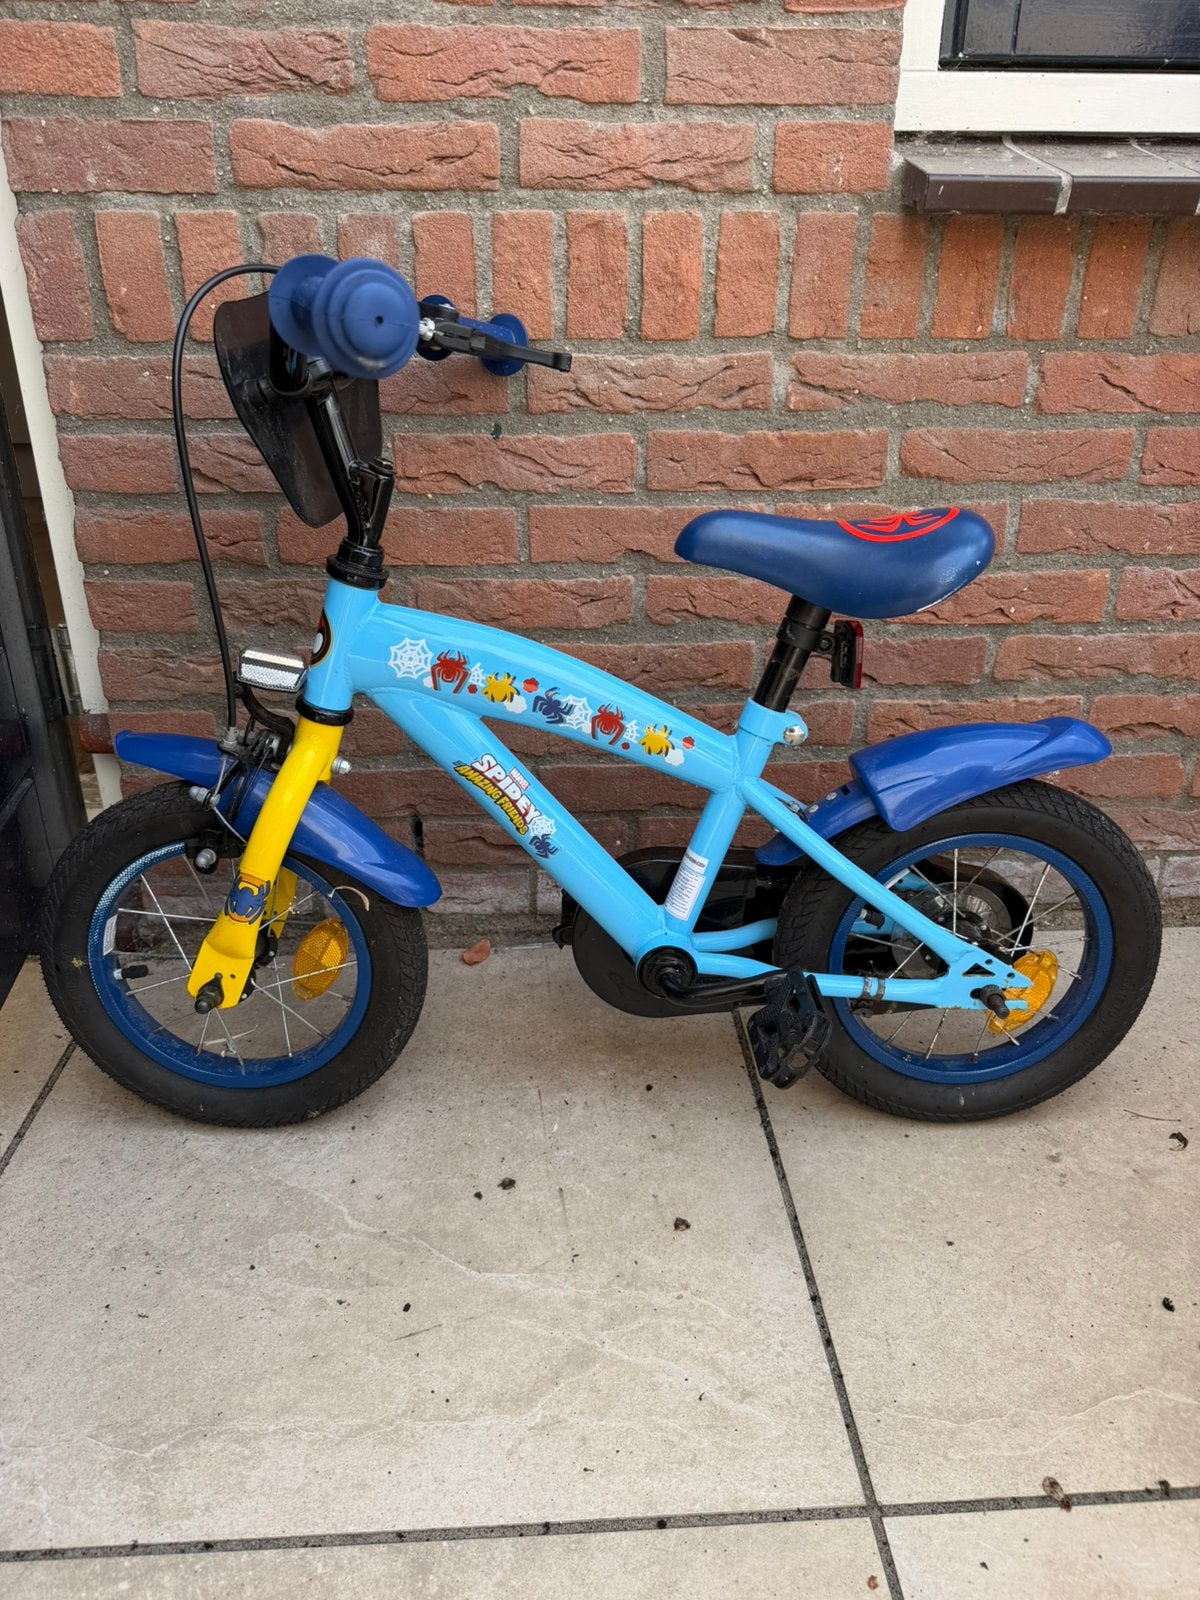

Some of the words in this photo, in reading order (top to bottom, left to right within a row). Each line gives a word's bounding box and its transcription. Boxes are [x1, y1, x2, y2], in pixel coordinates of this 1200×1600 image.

[455, 765, 502, 800] AMAZING
[497, 796, 528, 836] FRIENDS
[471, 753, 541, 824] SPIDEY
[510, 768, 529, 790] MARVEL
